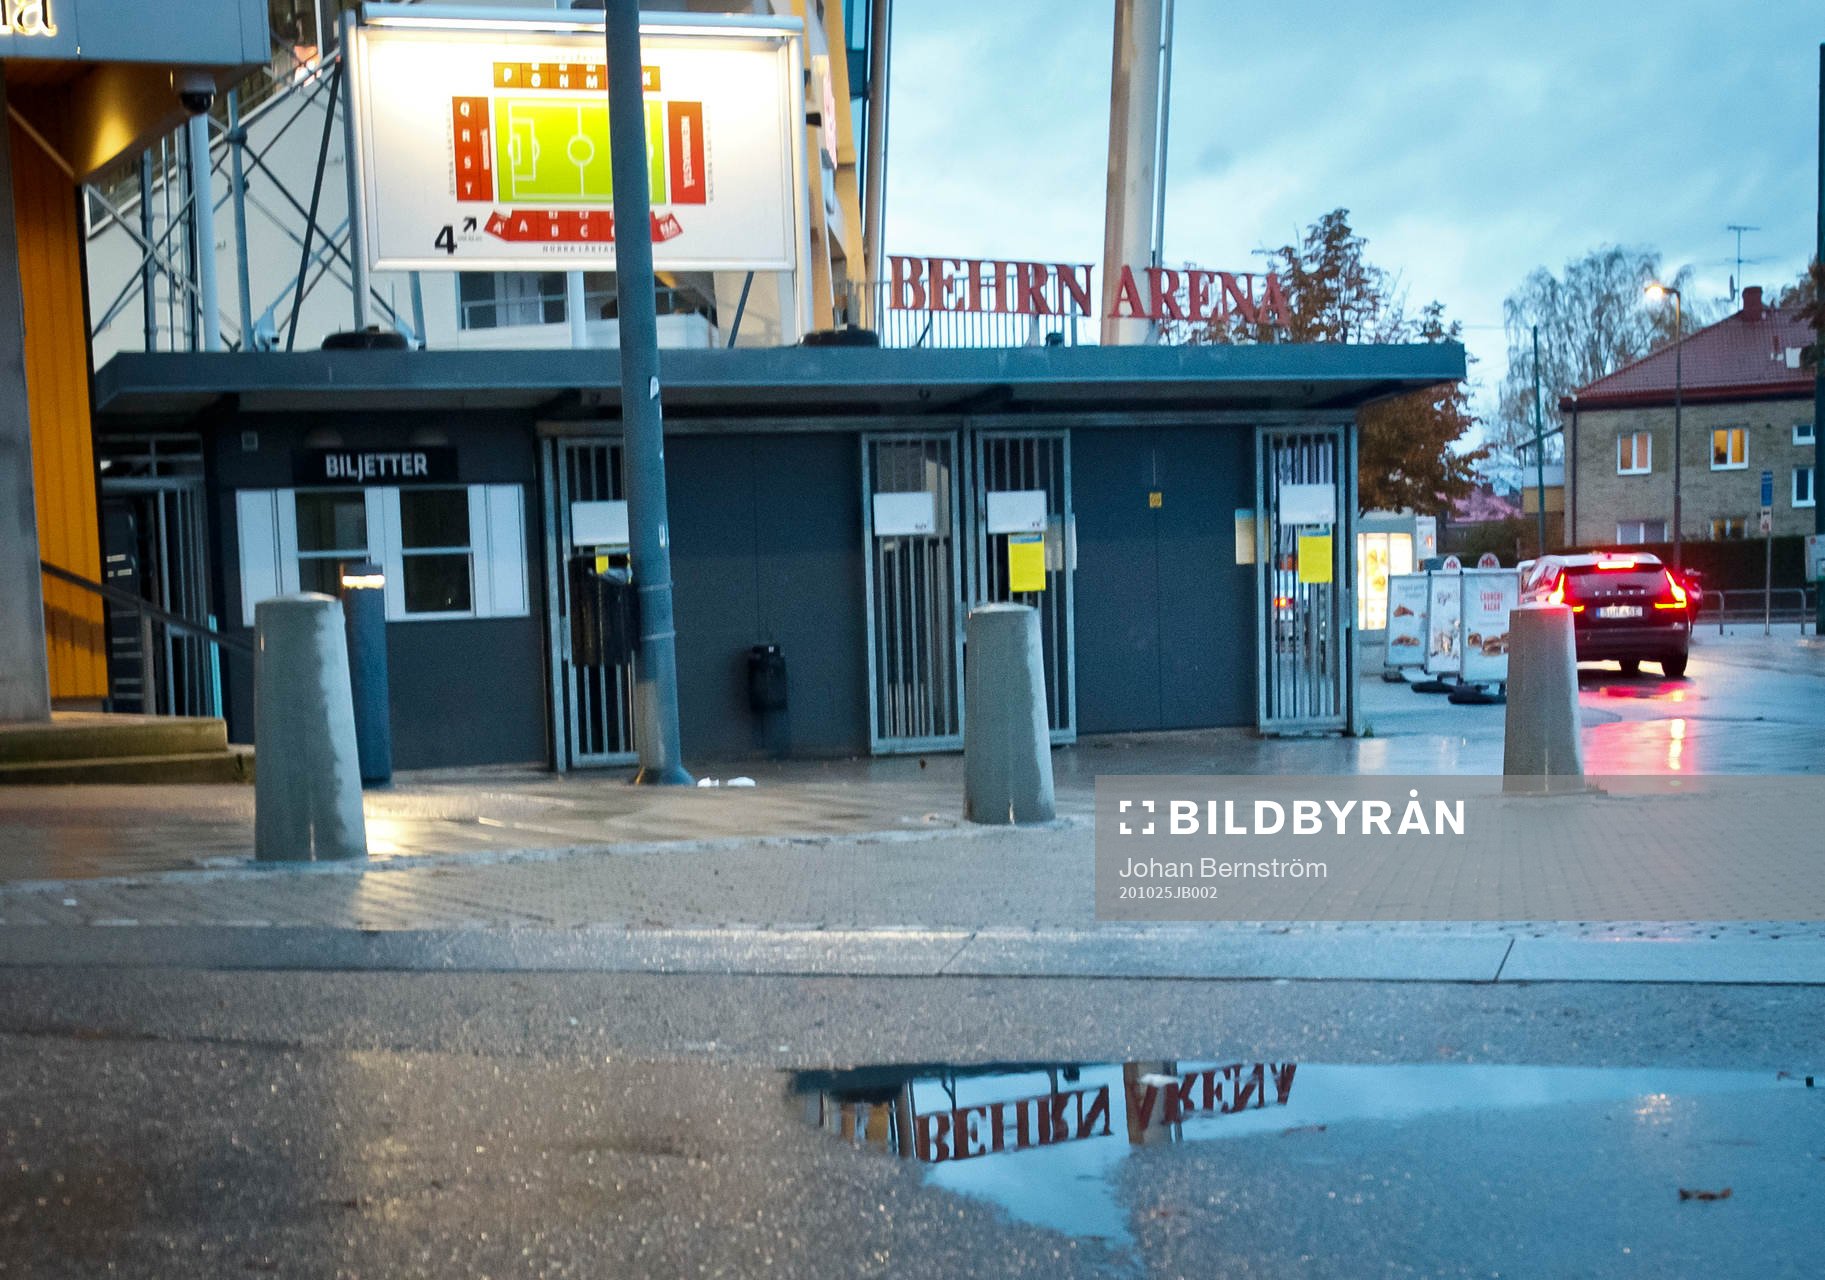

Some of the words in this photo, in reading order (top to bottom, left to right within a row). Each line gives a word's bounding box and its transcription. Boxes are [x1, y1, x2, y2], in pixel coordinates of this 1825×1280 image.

[434, 224, 458, 255] 4
[519, 219, 528, 233] A
[887, 255, 1095, 317] BEHRN
[1108, 264, 1291, 327] ARENA
[325, 453, 428, 481] BILJETTER
